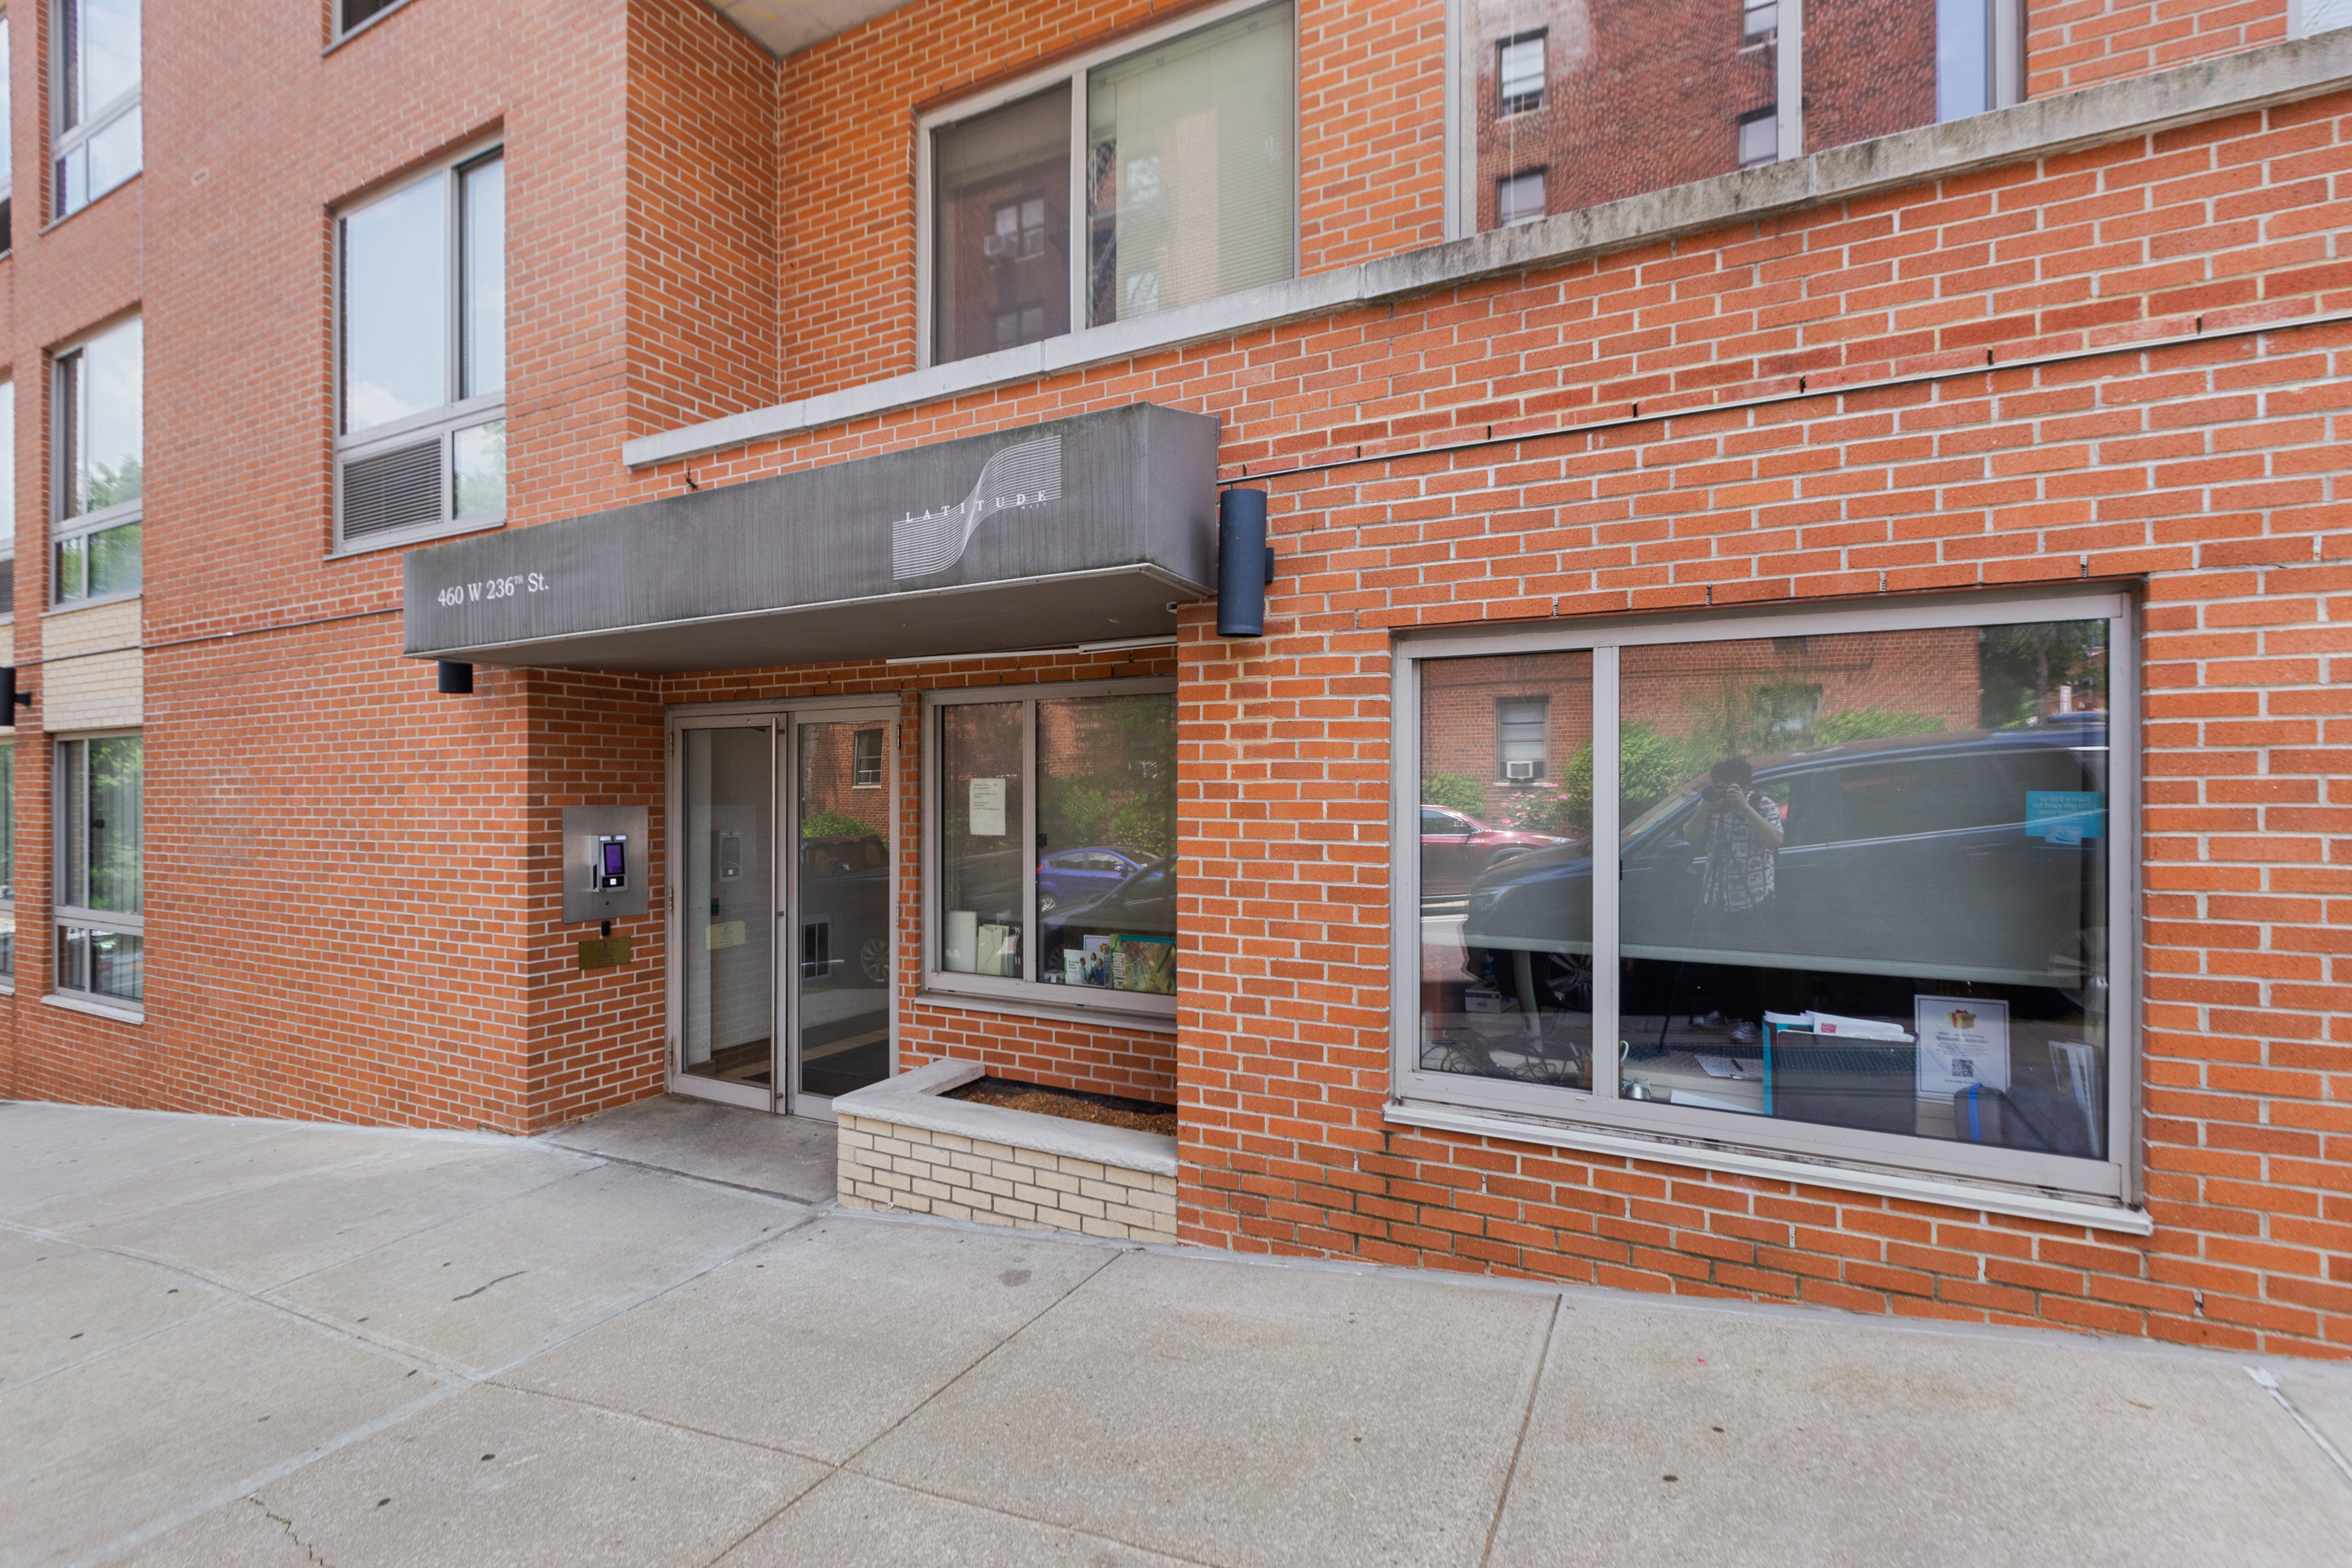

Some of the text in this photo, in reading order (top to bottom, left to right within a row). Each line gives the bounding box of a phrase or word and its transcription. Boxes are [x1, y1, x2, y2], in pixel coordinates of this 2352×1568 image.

[906, 490, 1046, 523] LATITUDE
[438, 572, 549, 607] 460 W 236TH St.
[1112, 952, 1126, 978] Dental
